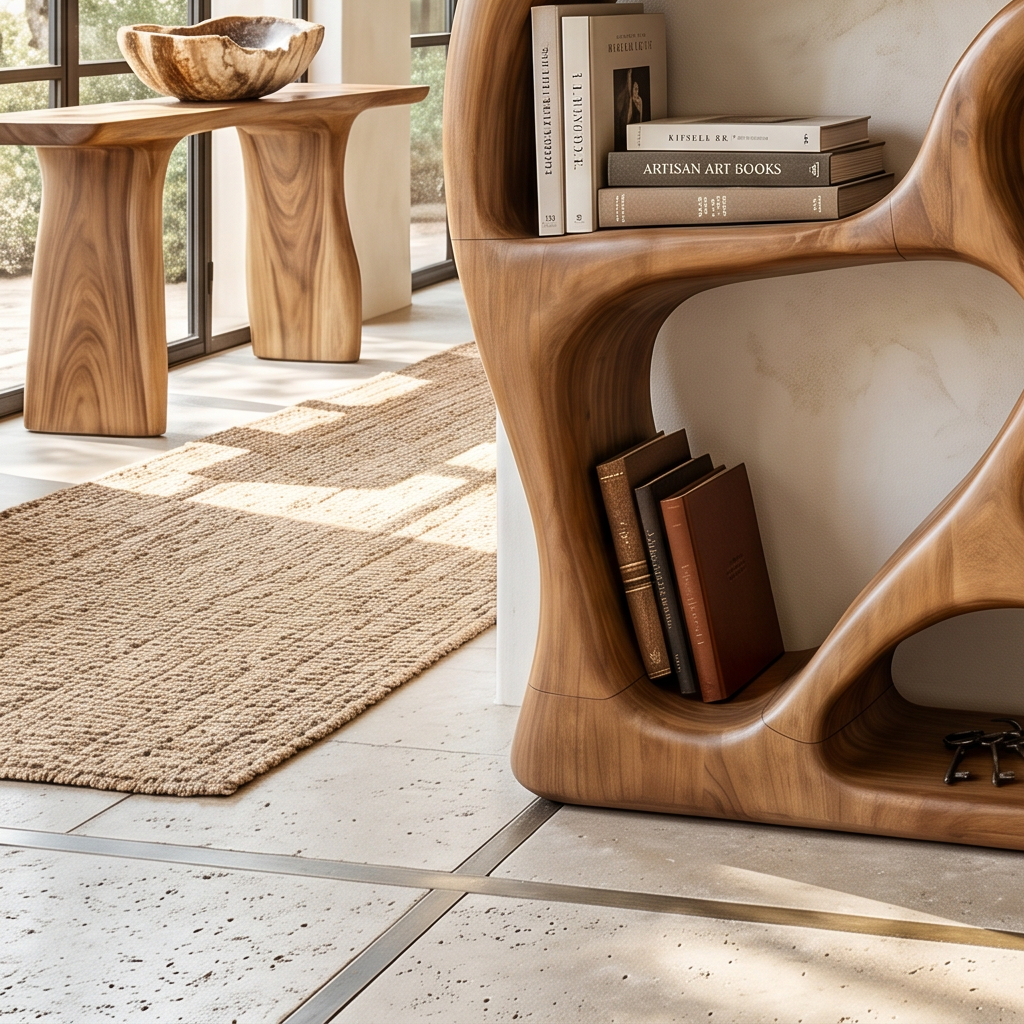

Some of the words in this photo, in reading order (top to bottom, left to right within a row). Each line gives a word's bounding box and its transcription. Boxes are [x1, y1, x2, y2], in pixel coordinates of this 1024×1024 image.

[643, 163, 701, 175] ARTISAN
[704, 163, 731, 175] ART
[735, 163, 782, 175] BOOKS
